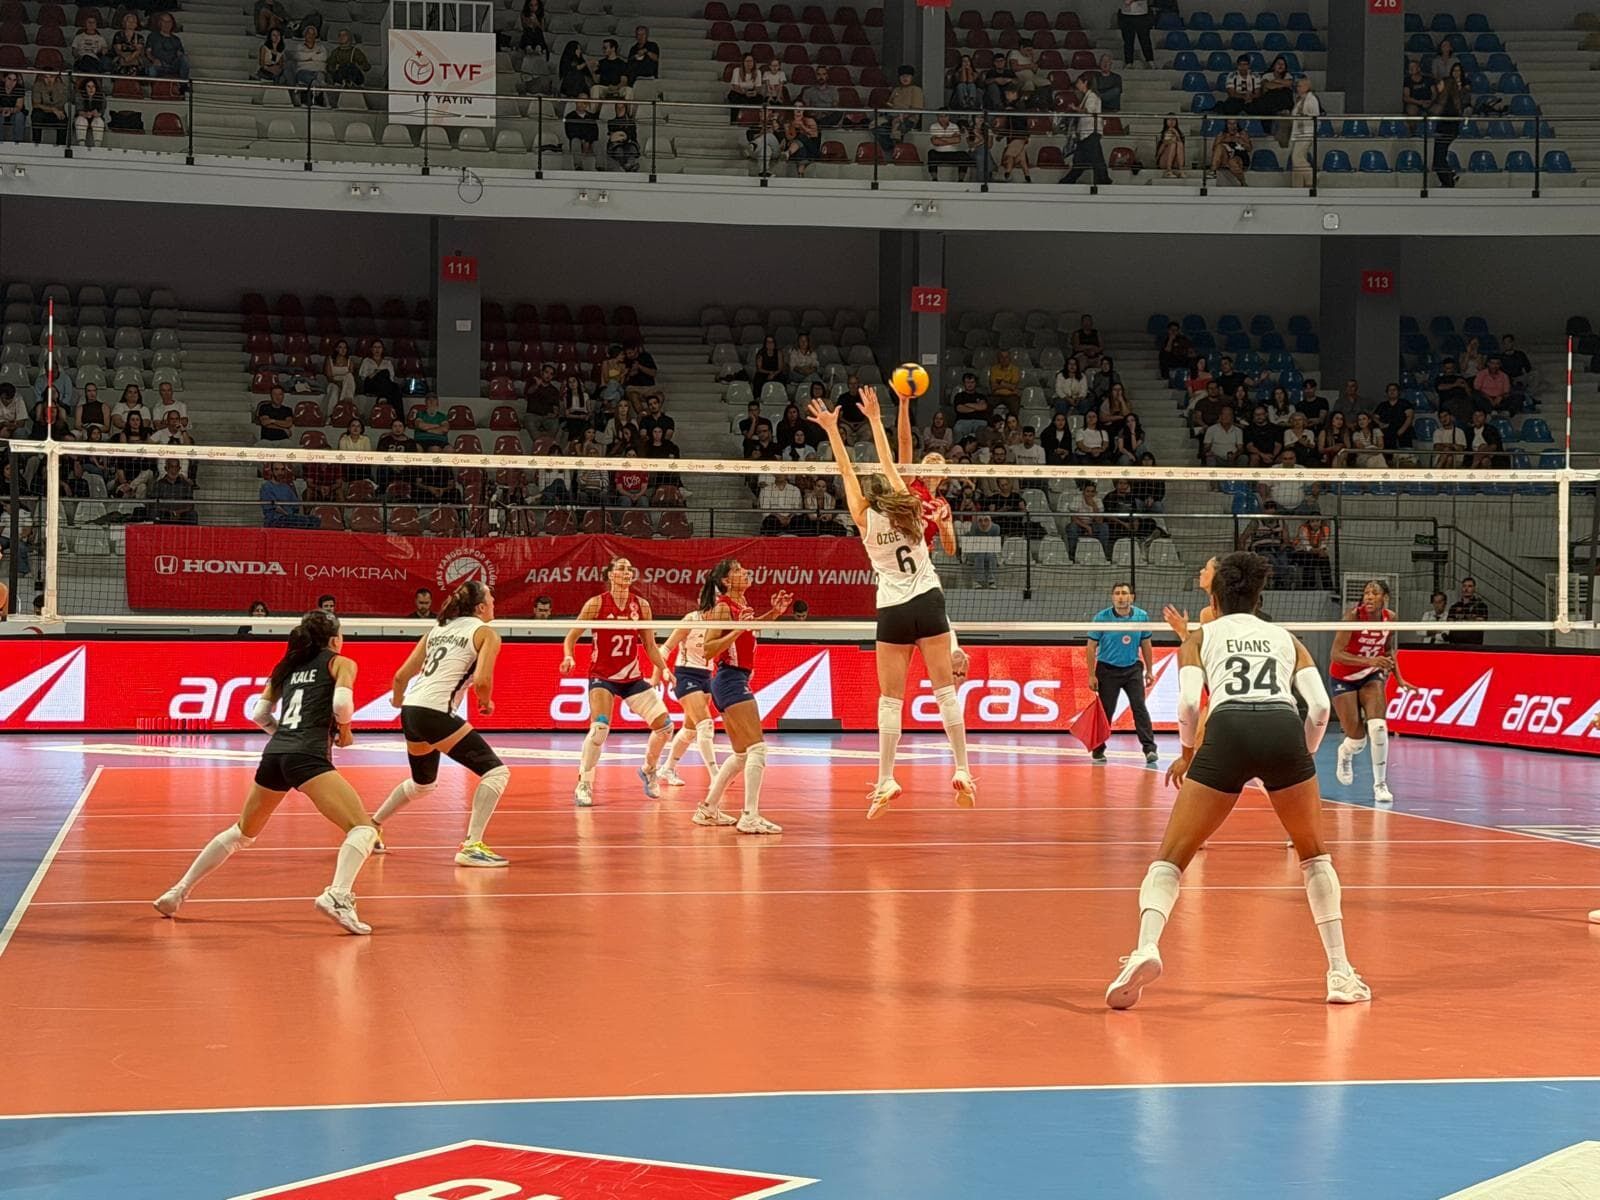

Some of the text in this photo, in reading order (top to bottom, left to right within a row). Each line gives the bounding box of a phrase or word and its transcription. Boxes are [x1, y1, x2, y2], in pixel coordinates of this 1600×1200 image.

[439, 63, 482, 81] TVF
[435, 94, 473, 105] YAYIN
[447, 262, 471, 275] 111
[1367, 276, 1389, 289] 113
[918, 293, 942, 307] 112
[182, 559, 408, 581] HONDA ÇAMKIRAN
[896, 545, 918, 575] 6
[525, 567, 573, 583] ARAS
[644, 568, 691, 584] SPOR
[611, 634, 634, 657] 27
[1226, 639, 1271, 653] EVANS
[290, 669, 318, 685] KALE
[1225, 656, 1282, 696] 34
[281, 688, 304, 730] 4
[911, 679, 1062, 723] aras
[1385, 686, 1445, 723] aras
[1502, 694, 1572, 735] aras
